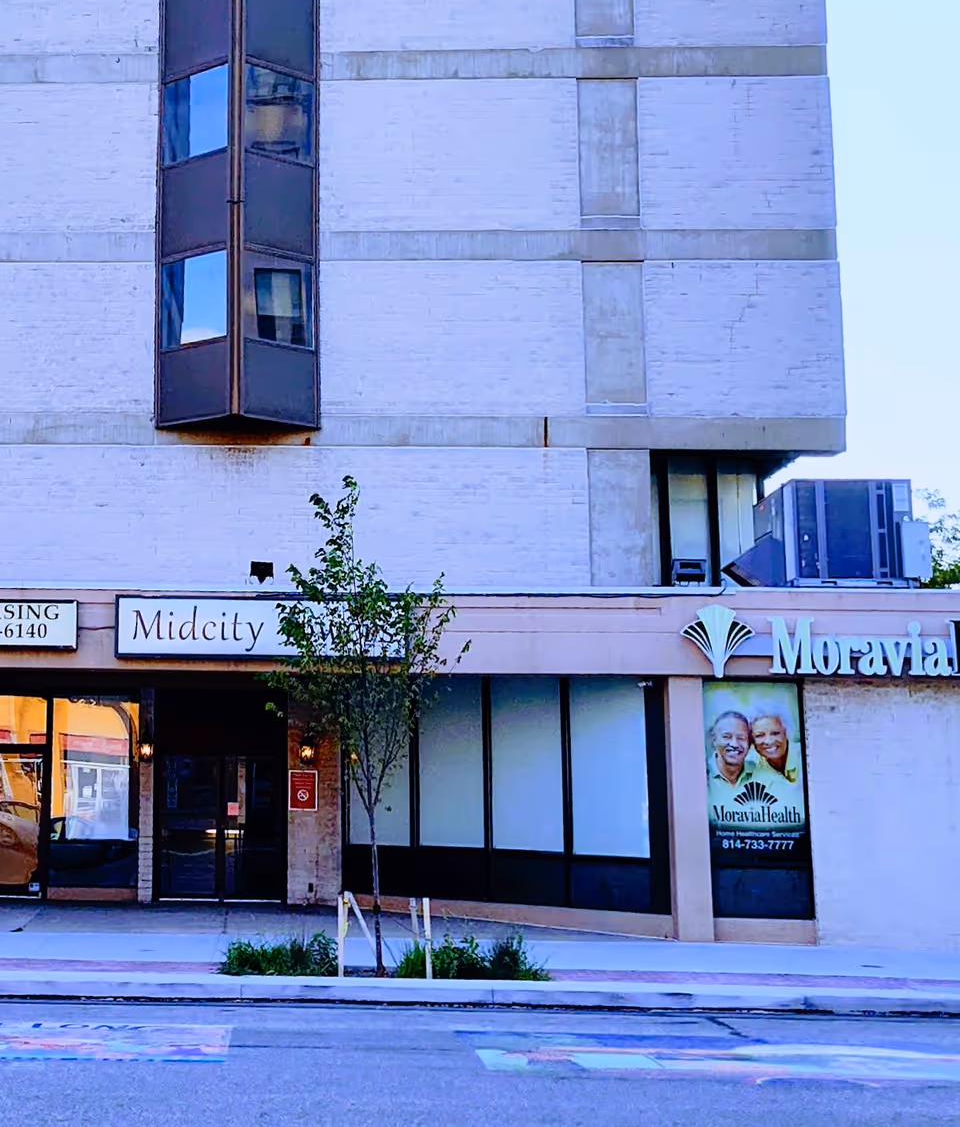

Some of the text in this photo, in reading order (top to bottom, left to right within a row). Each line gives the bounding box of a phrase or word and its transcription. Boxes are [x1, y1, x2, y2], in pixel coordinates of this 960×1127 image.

[132, 605, 265, 652] Midcity
[713, 805, 801, 823] MoraviaHealth
[722, 839, 795, 850] 814-733-7777
